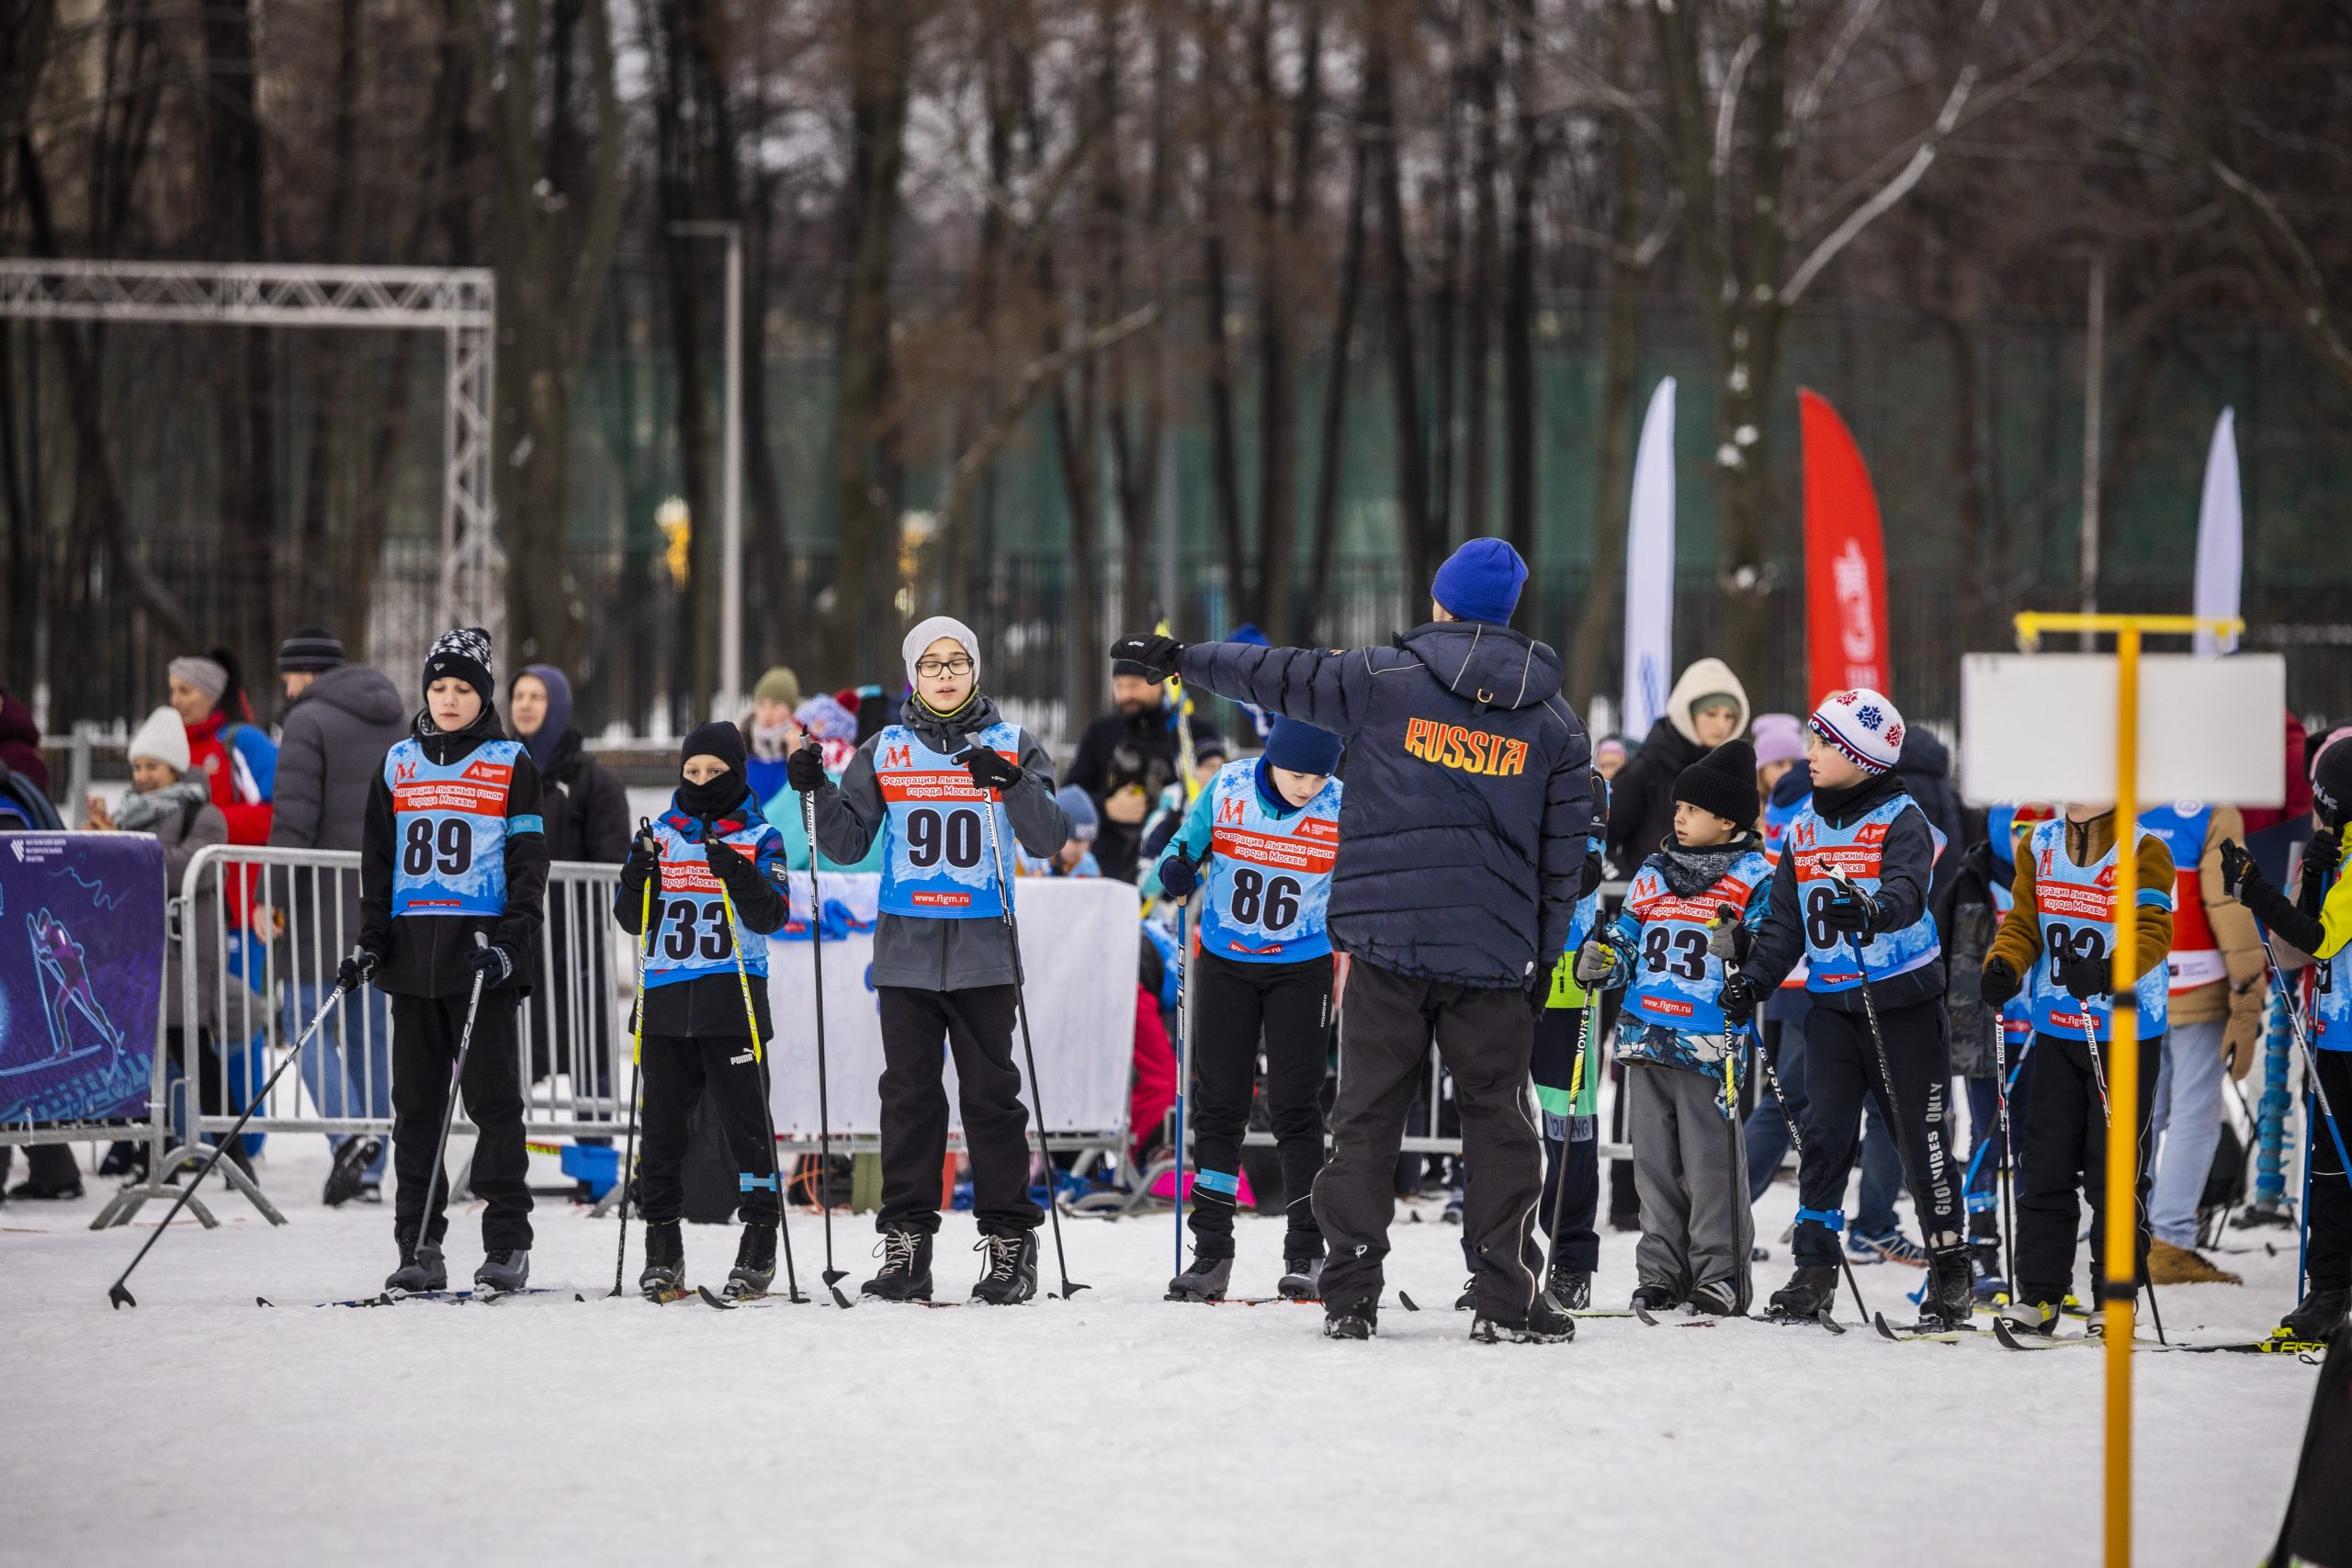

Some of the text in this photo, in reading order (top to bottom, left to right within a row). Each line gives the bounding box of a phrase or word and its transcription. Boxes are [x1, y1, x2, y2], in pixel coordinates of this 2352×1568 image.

[1405, 717, 1528, 776] RUSSIA
[880, 774, 936, 786] Федерация
[408, 795, 477, 808] города Москвы
[435, 785, 476, 796] лыжных
[477, 788, 504, 801] гонок
[906, 786, 984, 797] города Москвы
[402, 817, 472, 876] 89
[906, 807, 981, 870] 90
[1215, 829, 1336, 860] Федерация лыжных гонок
[1234, 845, 1306, 866] города Москвы
[914, 894, 969, 905] www.flgm.ru
[1230, 867, 1301, 931] 86
[2036, 886, 2069, 897] дерация
[2070, 889, 2106, 905] лыжных
[1677, 904, 1715, 919] Москвы
[2044, 898, 2107, 917] города Москвы
[1642, 926, 1709, 982] 83
[1642, 996, 1692, 1013] www.flgm.ru
[2084, 1016, 2097, 1054] NORDWAY
[730, 1054, 753, 1065] PUMA
[1926, 1082, 1943, 1122] ONLY
[1928, 1130, 1945, 1180] VIBES
